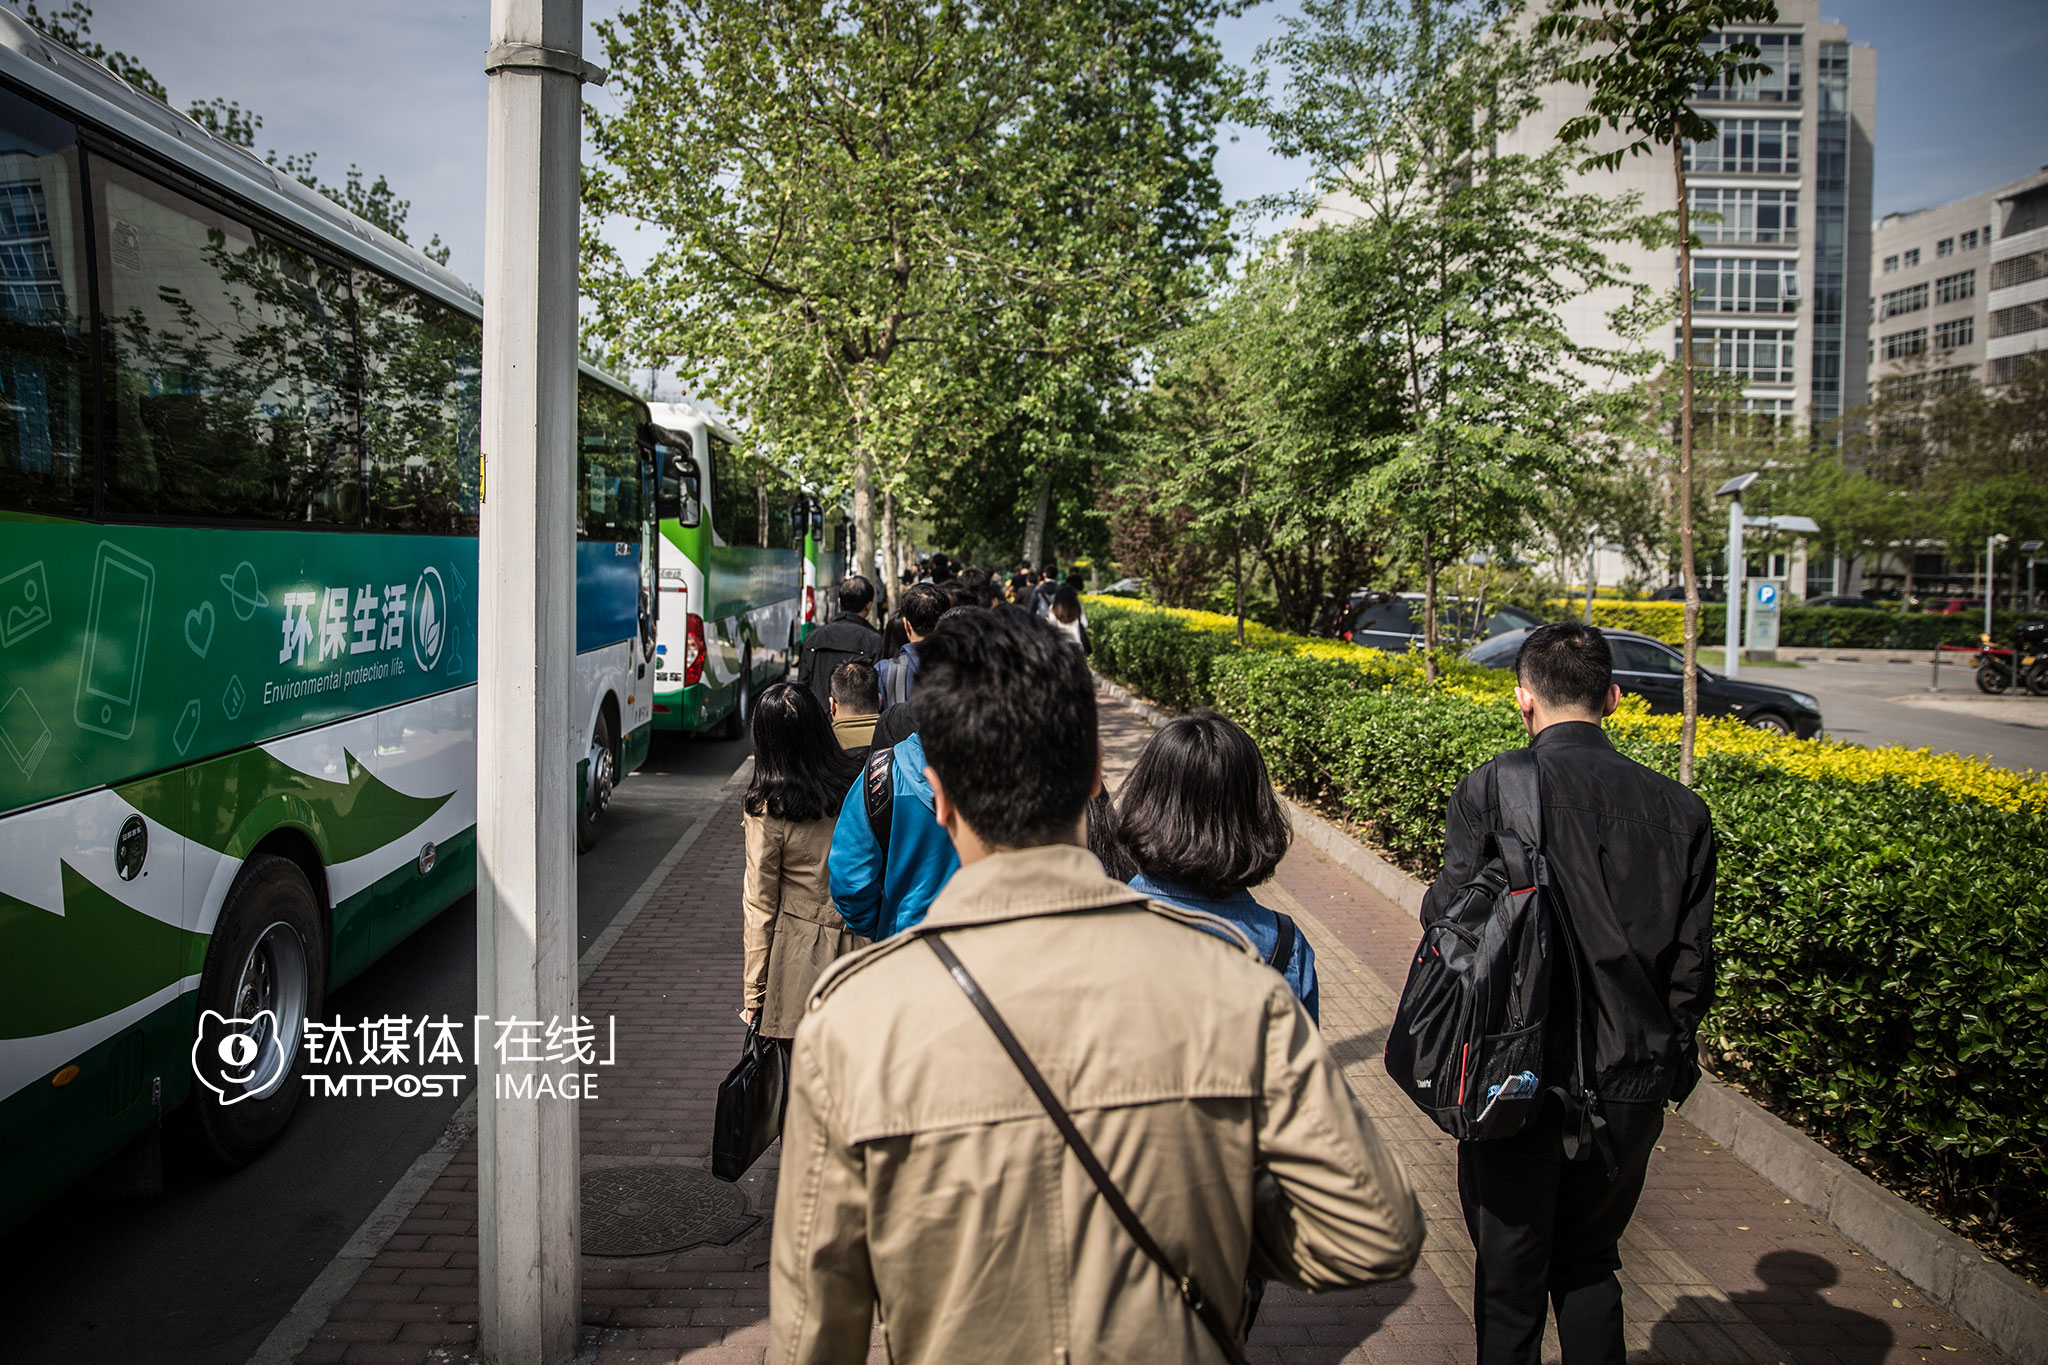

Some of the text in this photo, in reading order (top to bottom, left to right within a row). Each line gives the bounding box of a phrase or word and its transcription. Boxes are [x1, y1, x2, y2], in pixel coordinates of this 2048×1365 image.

[279, 583, 407, 667] 环保生活
[263, 657, 406, 705] Environmental protection life.
